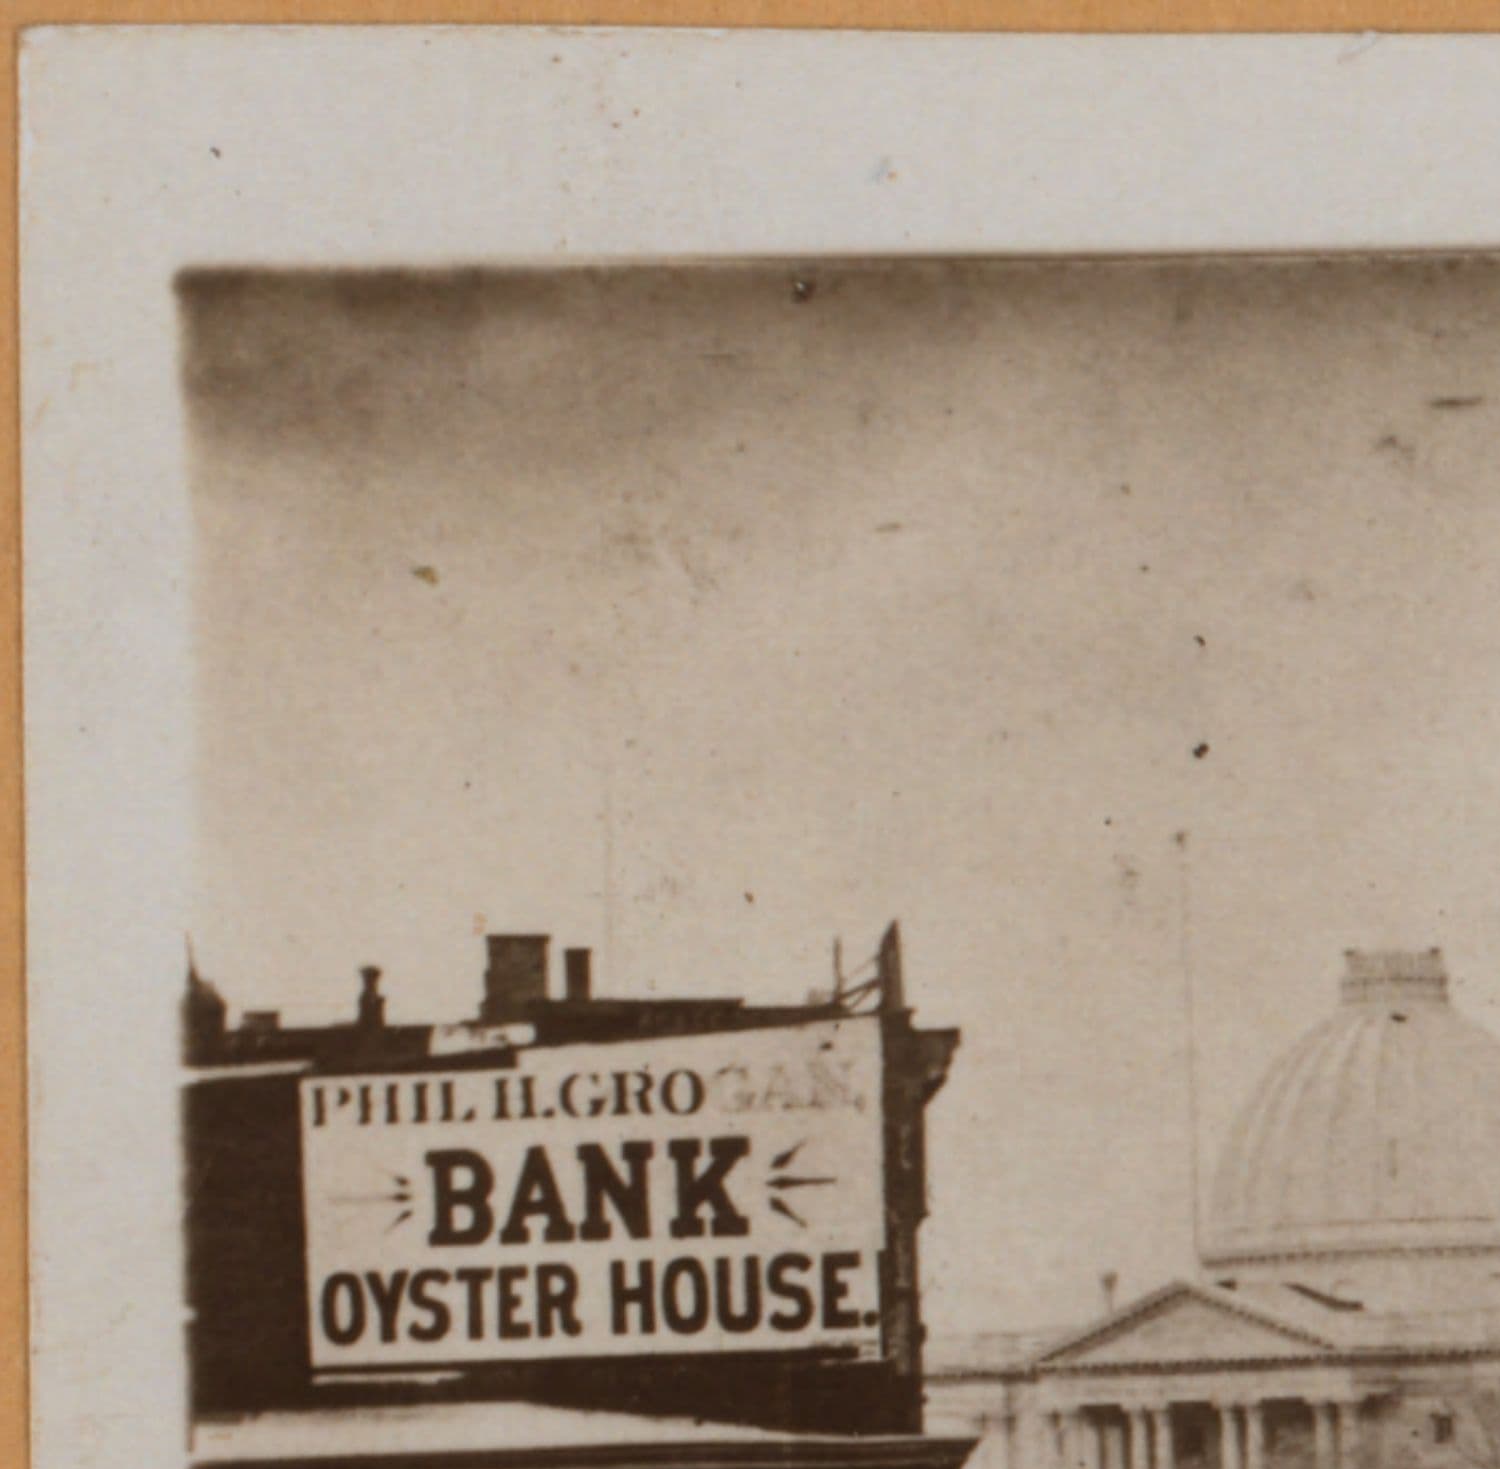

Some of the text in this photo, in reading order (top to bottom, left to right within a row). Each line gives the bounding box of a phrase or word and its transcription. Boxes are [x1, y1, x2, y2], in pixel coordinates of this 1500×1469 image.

[311, 1078, 475, 1127] PHIL
[425, 1136, 751, 1247] BANK
[320, 1252, 879, 1346] OYSTER HOUSE.
